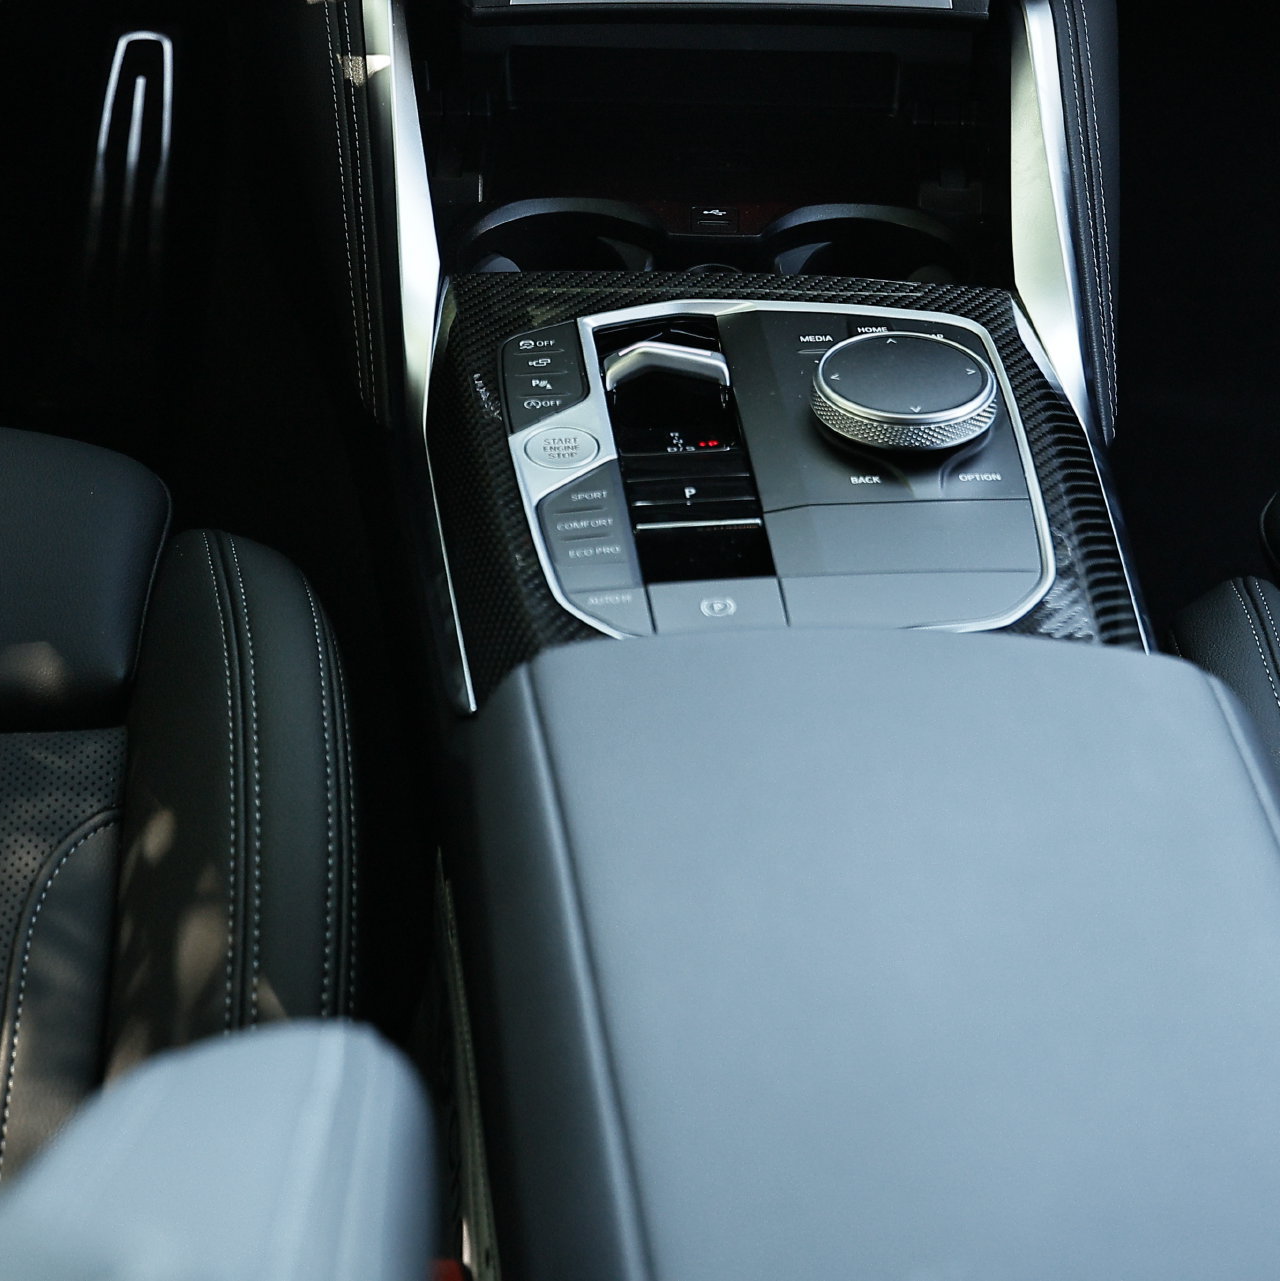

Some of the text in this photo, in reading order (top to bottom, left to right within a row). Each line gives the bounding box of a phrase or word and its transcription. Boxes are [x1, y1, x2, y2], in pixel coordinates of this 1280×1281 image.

[543, 437, 578, 446] START
[543, 445, 580, 453] ENGINE
[548, 452, 578, 460] STOP
[851, 476, 881, 485] BACK
[959, 473, 1002, 482] OPTION
[570, 489, 608, 502] SPORT
[684, 487, 696, 499] P
[556, 518, 614, 531] COMFORT
[569, 546, 621, 559] ECO PRO
